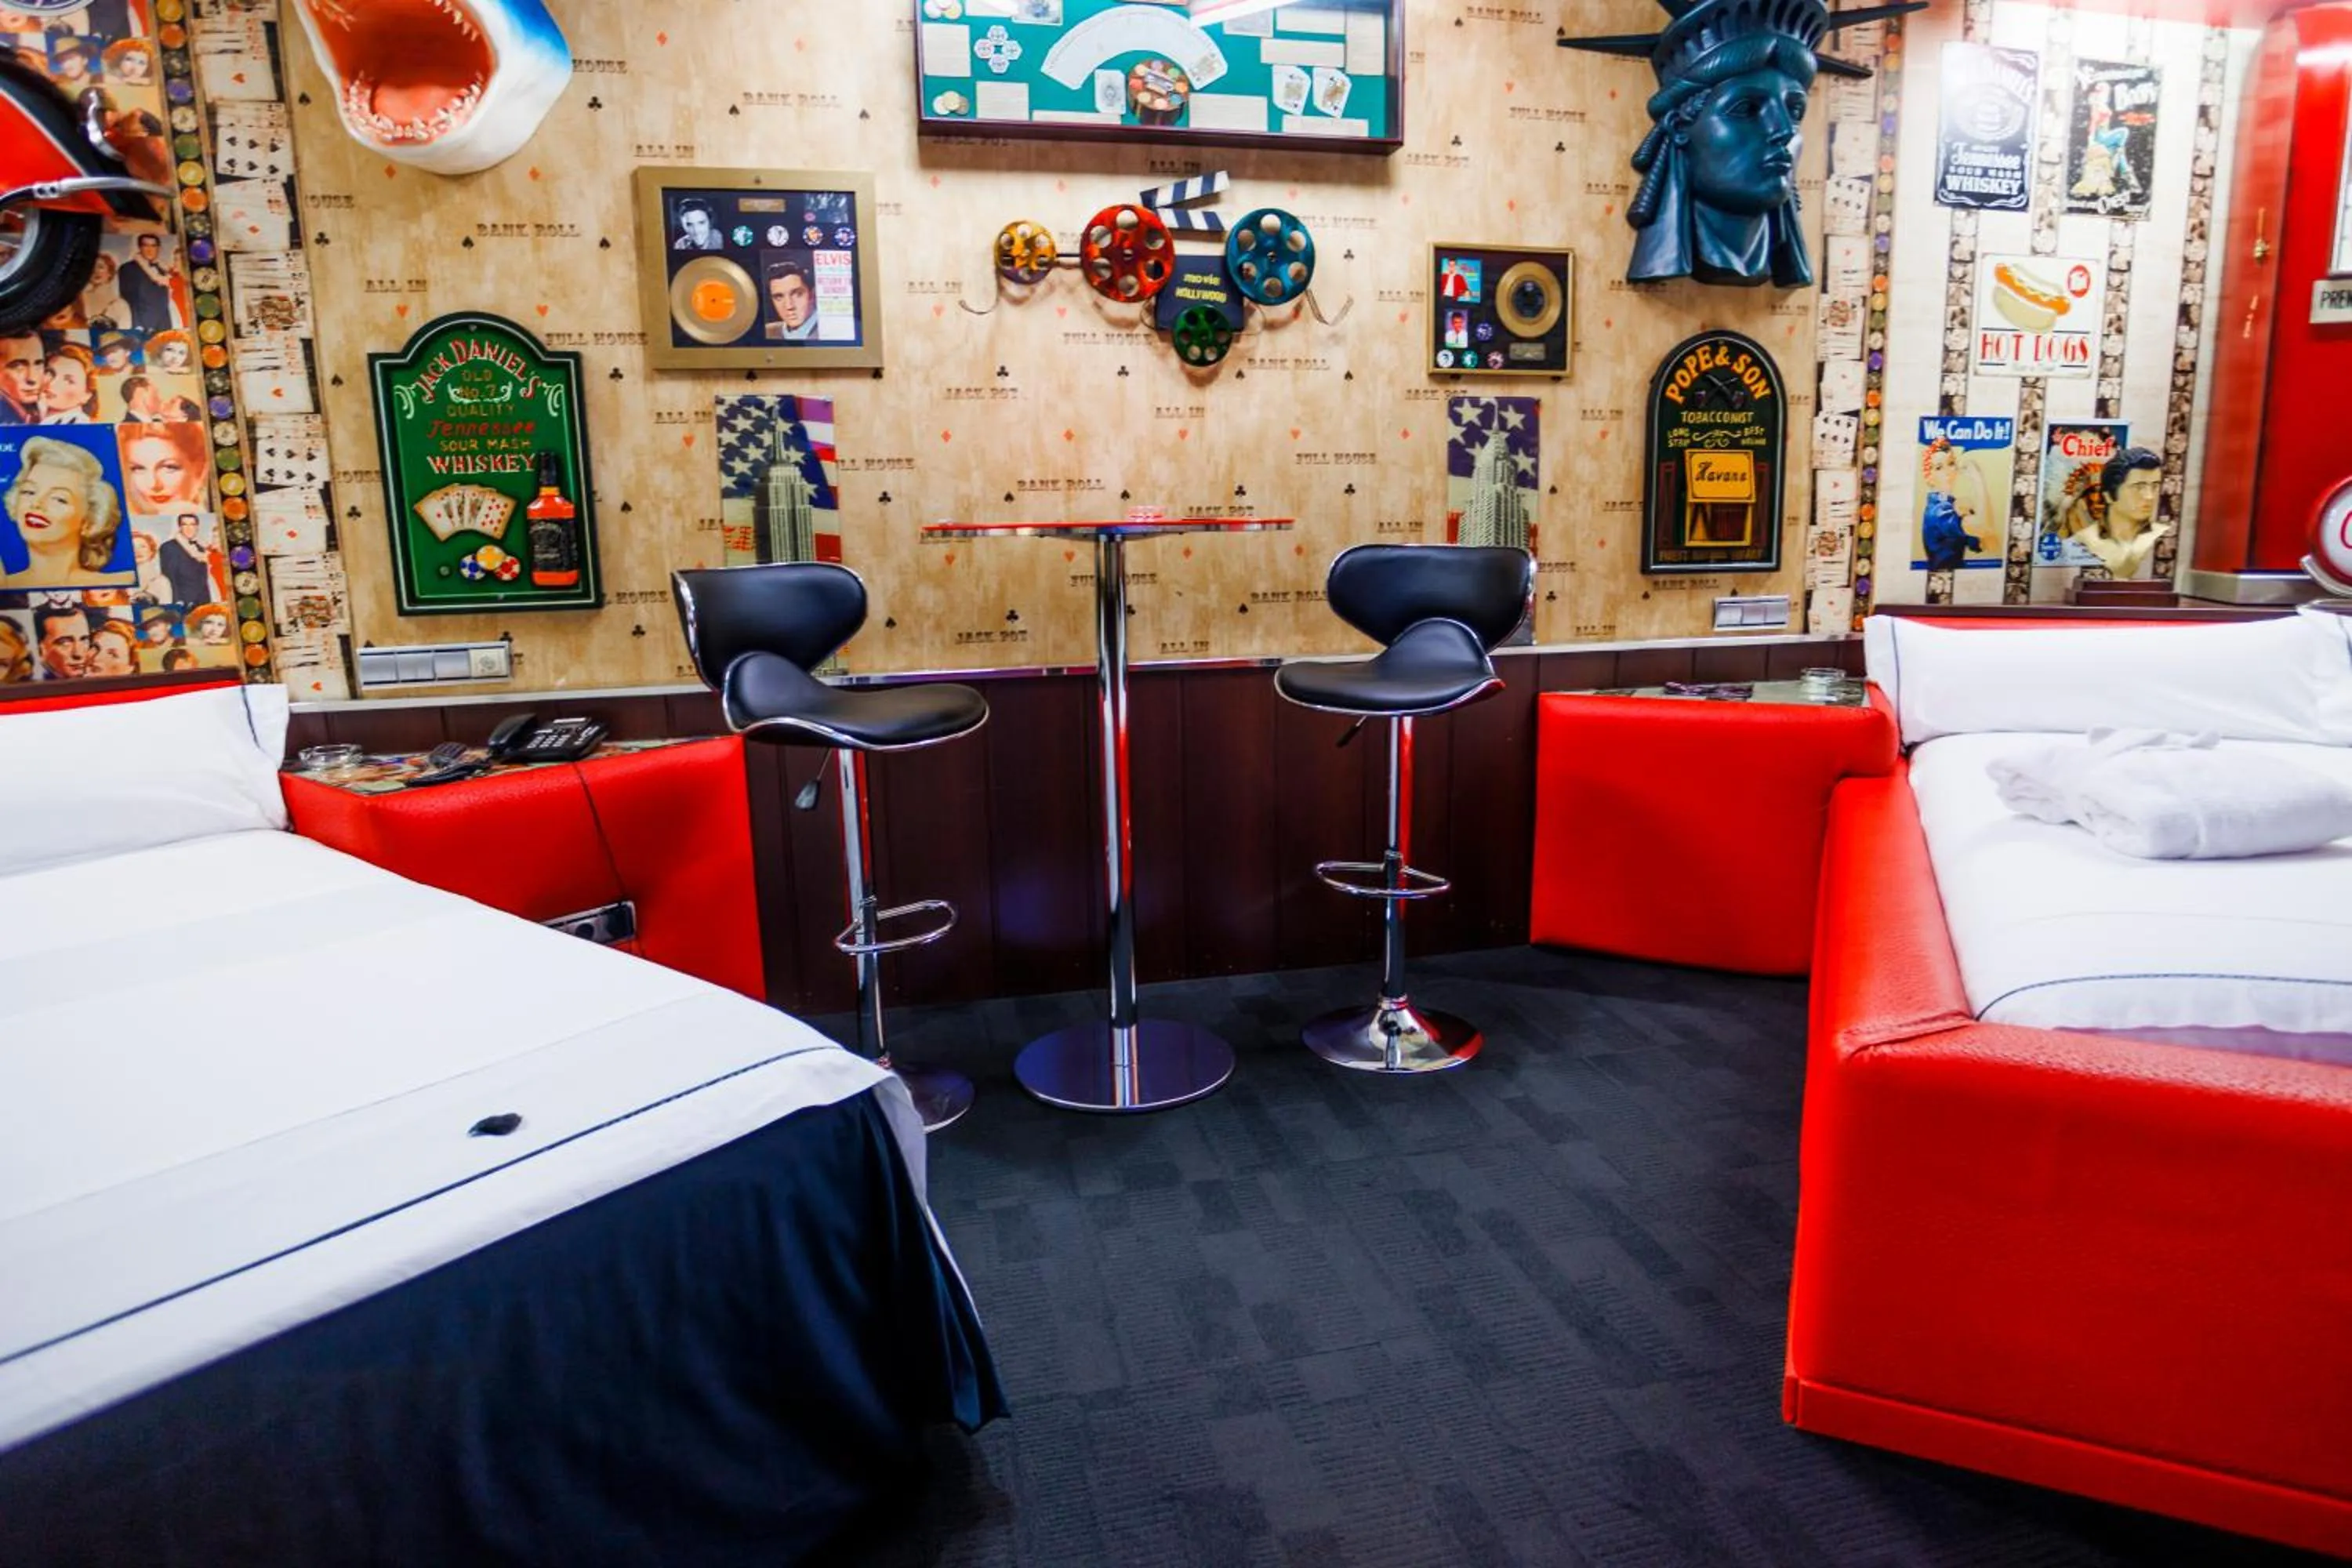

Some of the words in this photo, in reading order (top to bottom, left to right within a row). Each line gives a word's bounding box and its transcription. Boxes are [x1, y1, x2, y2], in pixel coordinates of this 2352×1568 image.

[1945, 174, 2023, 195] WHISKEY
[476, 223, 529, 237] BANK
[534, 223, 582, 237] ROLL
[815, 253, 851, 266] ELVIS
[364, 279, 402, 293] ALL
[407, 279, 428, 292] IN
[1174, 287, 1227, 303] HOLLYWOOD
[1980, 333, 2024, 362] HOT
[2034, 335, 2089, 363] DOGS
[414, 353, 453, 404] JACK
[448, 339, 543, 399] DANIEL'S
[462, 368, 493, 382] OLD
[1664, 345, 1715, 405] POPE
[1715, 346, 1730, 366] &
[1731, 354, 1772, 401] SON
[446, 404, 514, 417] QUALITY
[1680, 412, 1755, 424] TOBACCONIST
[1923, 419, 1945, 439] We
[1947, 419, 1973, 440] Can
[1973, 419, 1993, 441] Do
[1994, 420, 2011, 441] It!
[439, 438, 478, 452] SOUR
[486, 437, 532, 450] MASH
[2061, 432, 2114, 457] Chief
[426, 452, 536, 475] WHISKEY
[1694, 460, 1748, 482] Havana
[954, 631, 996, 644] JACK
[999, 630, 1029, 643] POT
